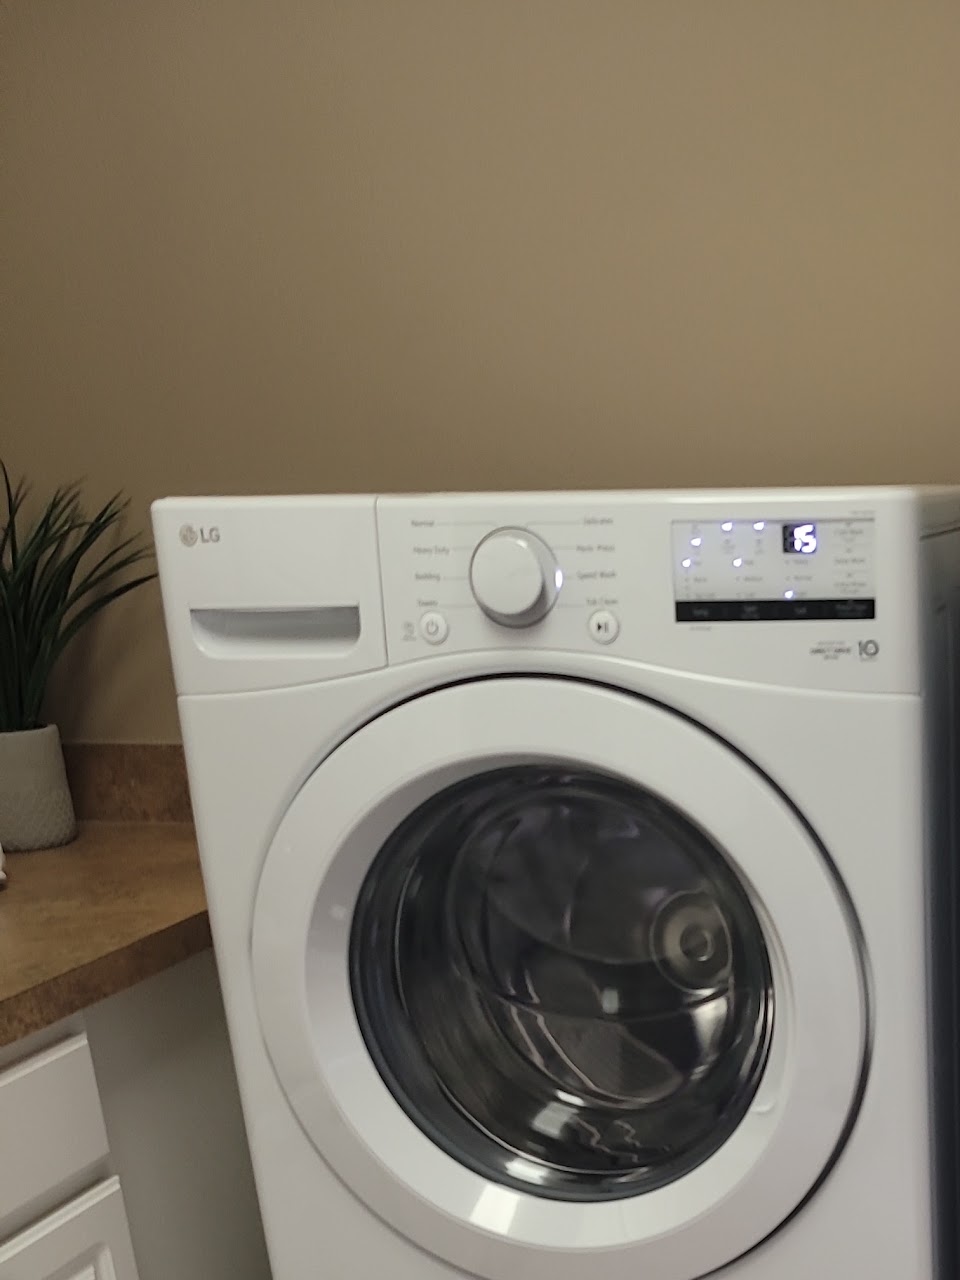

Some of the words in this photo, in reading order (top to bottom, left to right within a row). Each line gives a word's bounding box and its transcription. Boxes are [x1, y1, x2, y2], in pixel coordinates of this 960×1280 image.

[200, 527, 221, 543] LG
[793, 524, 817, 553] 15
[858, 640, 880, 657] 10
